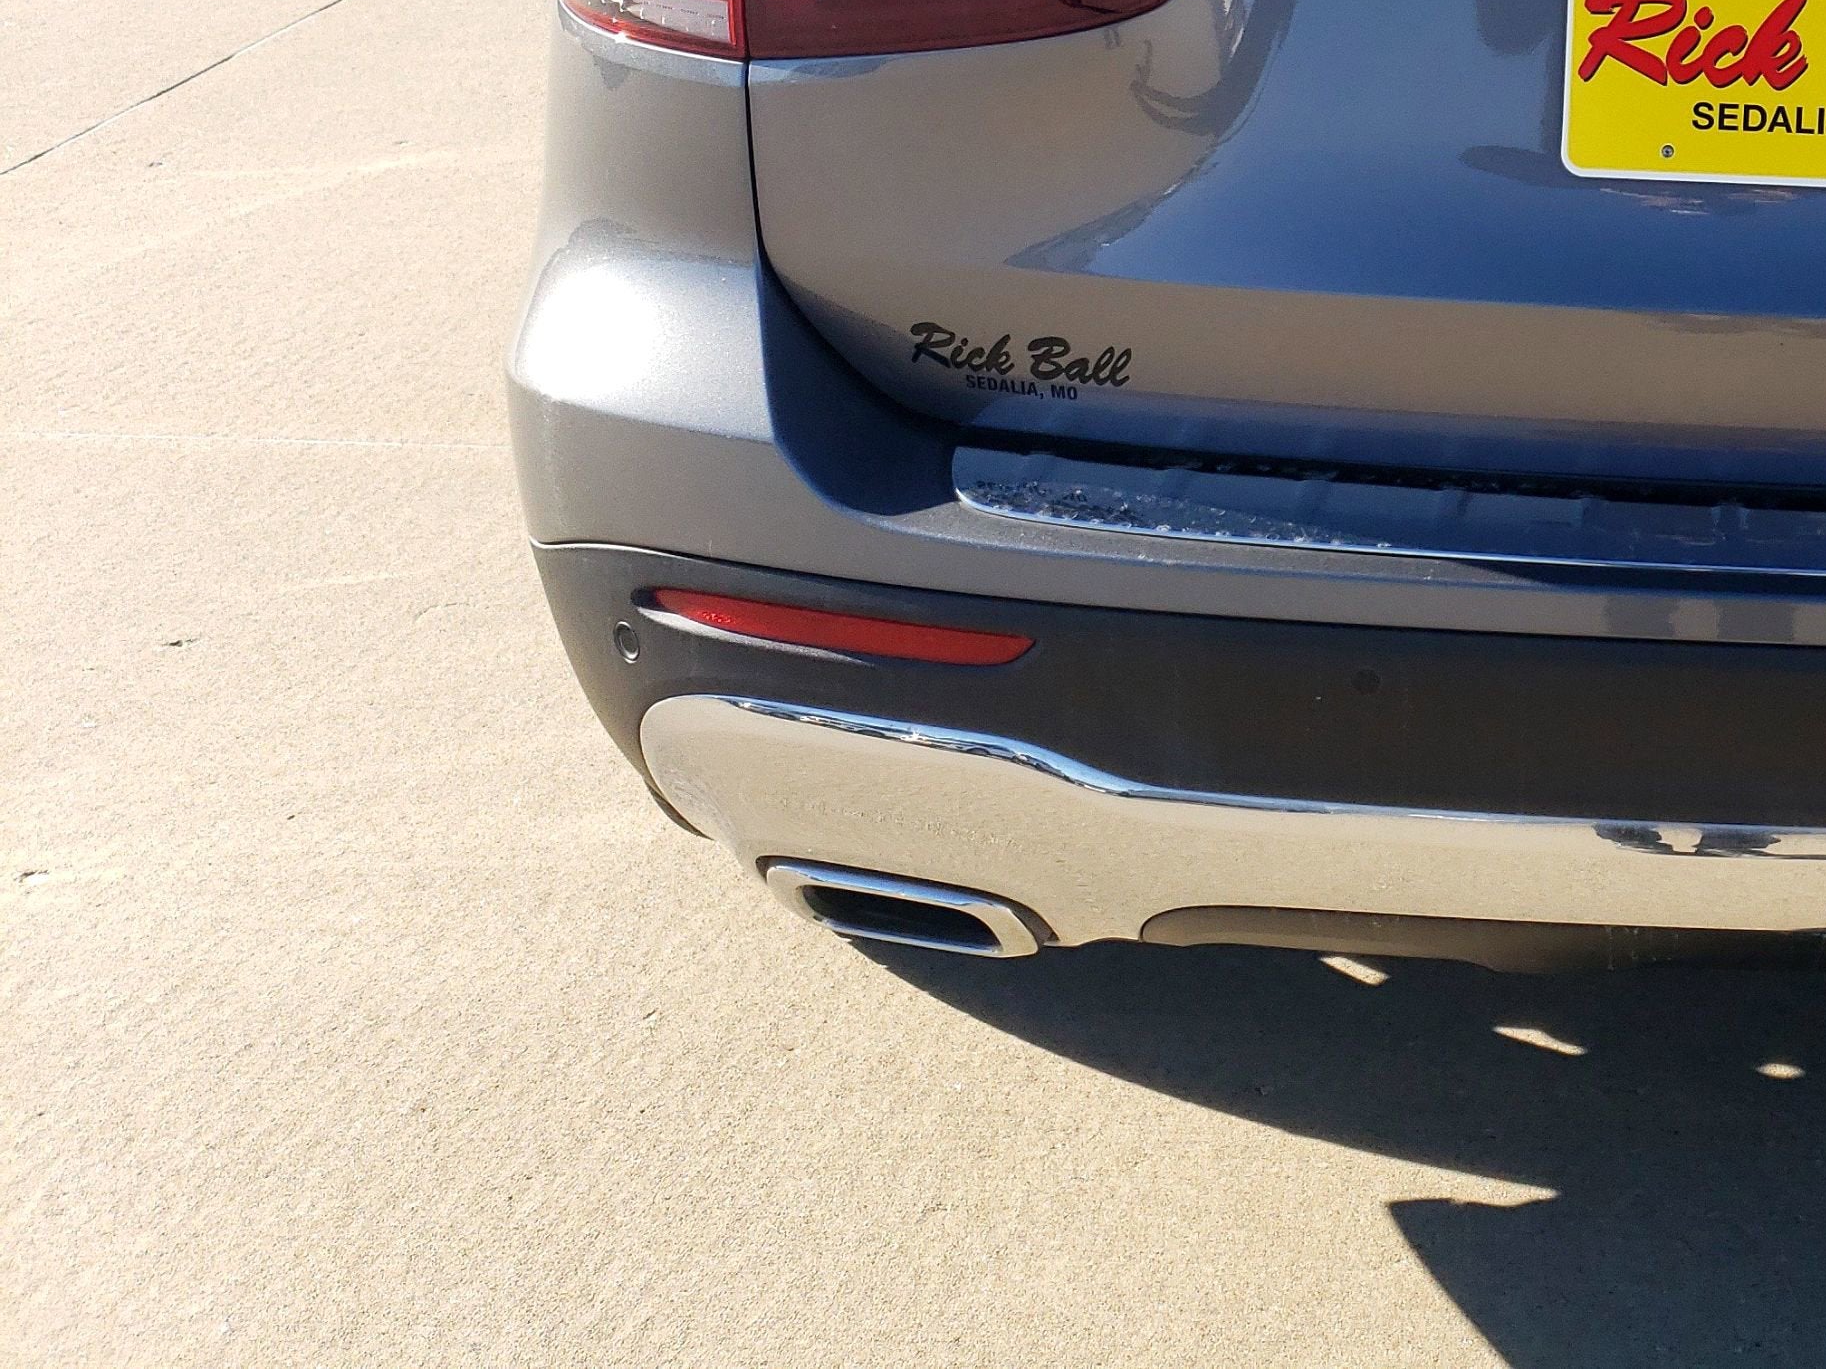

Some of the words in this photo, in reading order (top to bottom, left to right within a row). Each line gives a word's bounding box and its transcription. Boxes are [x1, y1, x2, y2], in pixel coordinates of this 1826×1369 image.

[910, 321, 1015, 376] Rick
[1027, 336, 1132, 387] Ball
[965, 374, 1044, 400] SEDALIA,
[1051, 384, 1078, 400] MO
